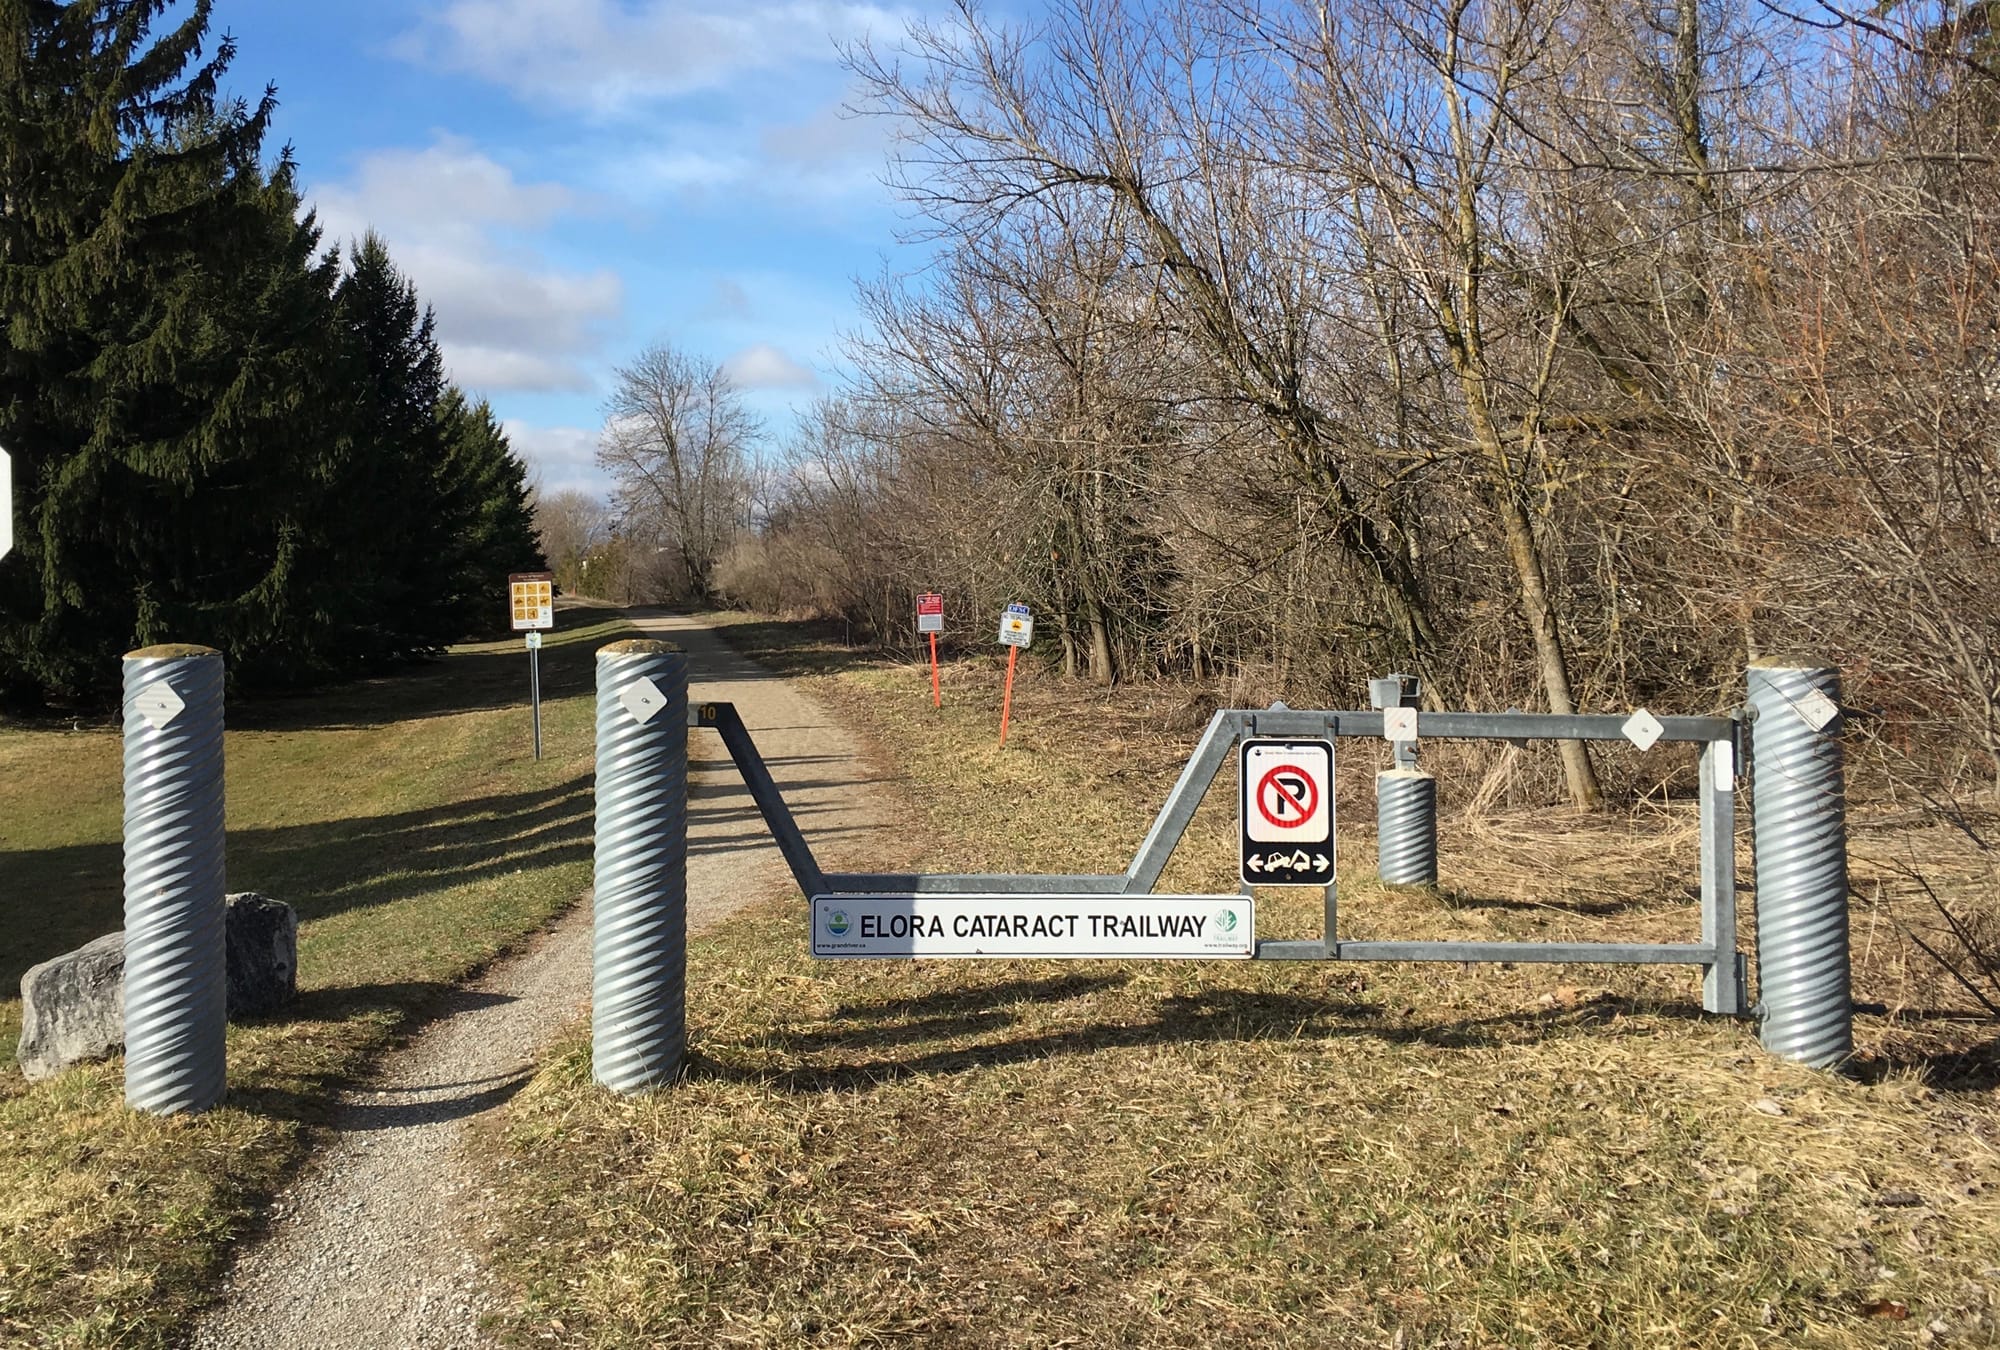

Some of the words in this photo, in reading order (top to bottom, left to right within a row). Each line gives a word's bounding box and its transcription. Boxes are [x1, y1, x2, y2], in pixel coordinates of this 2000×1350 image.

[700, 706, 716, 720] 10
[860, 915, 944, 938] ELORA
[953, 915, 1079, 938] CATARACT
[1088, 915, 1207, 938] TRAILWAY
